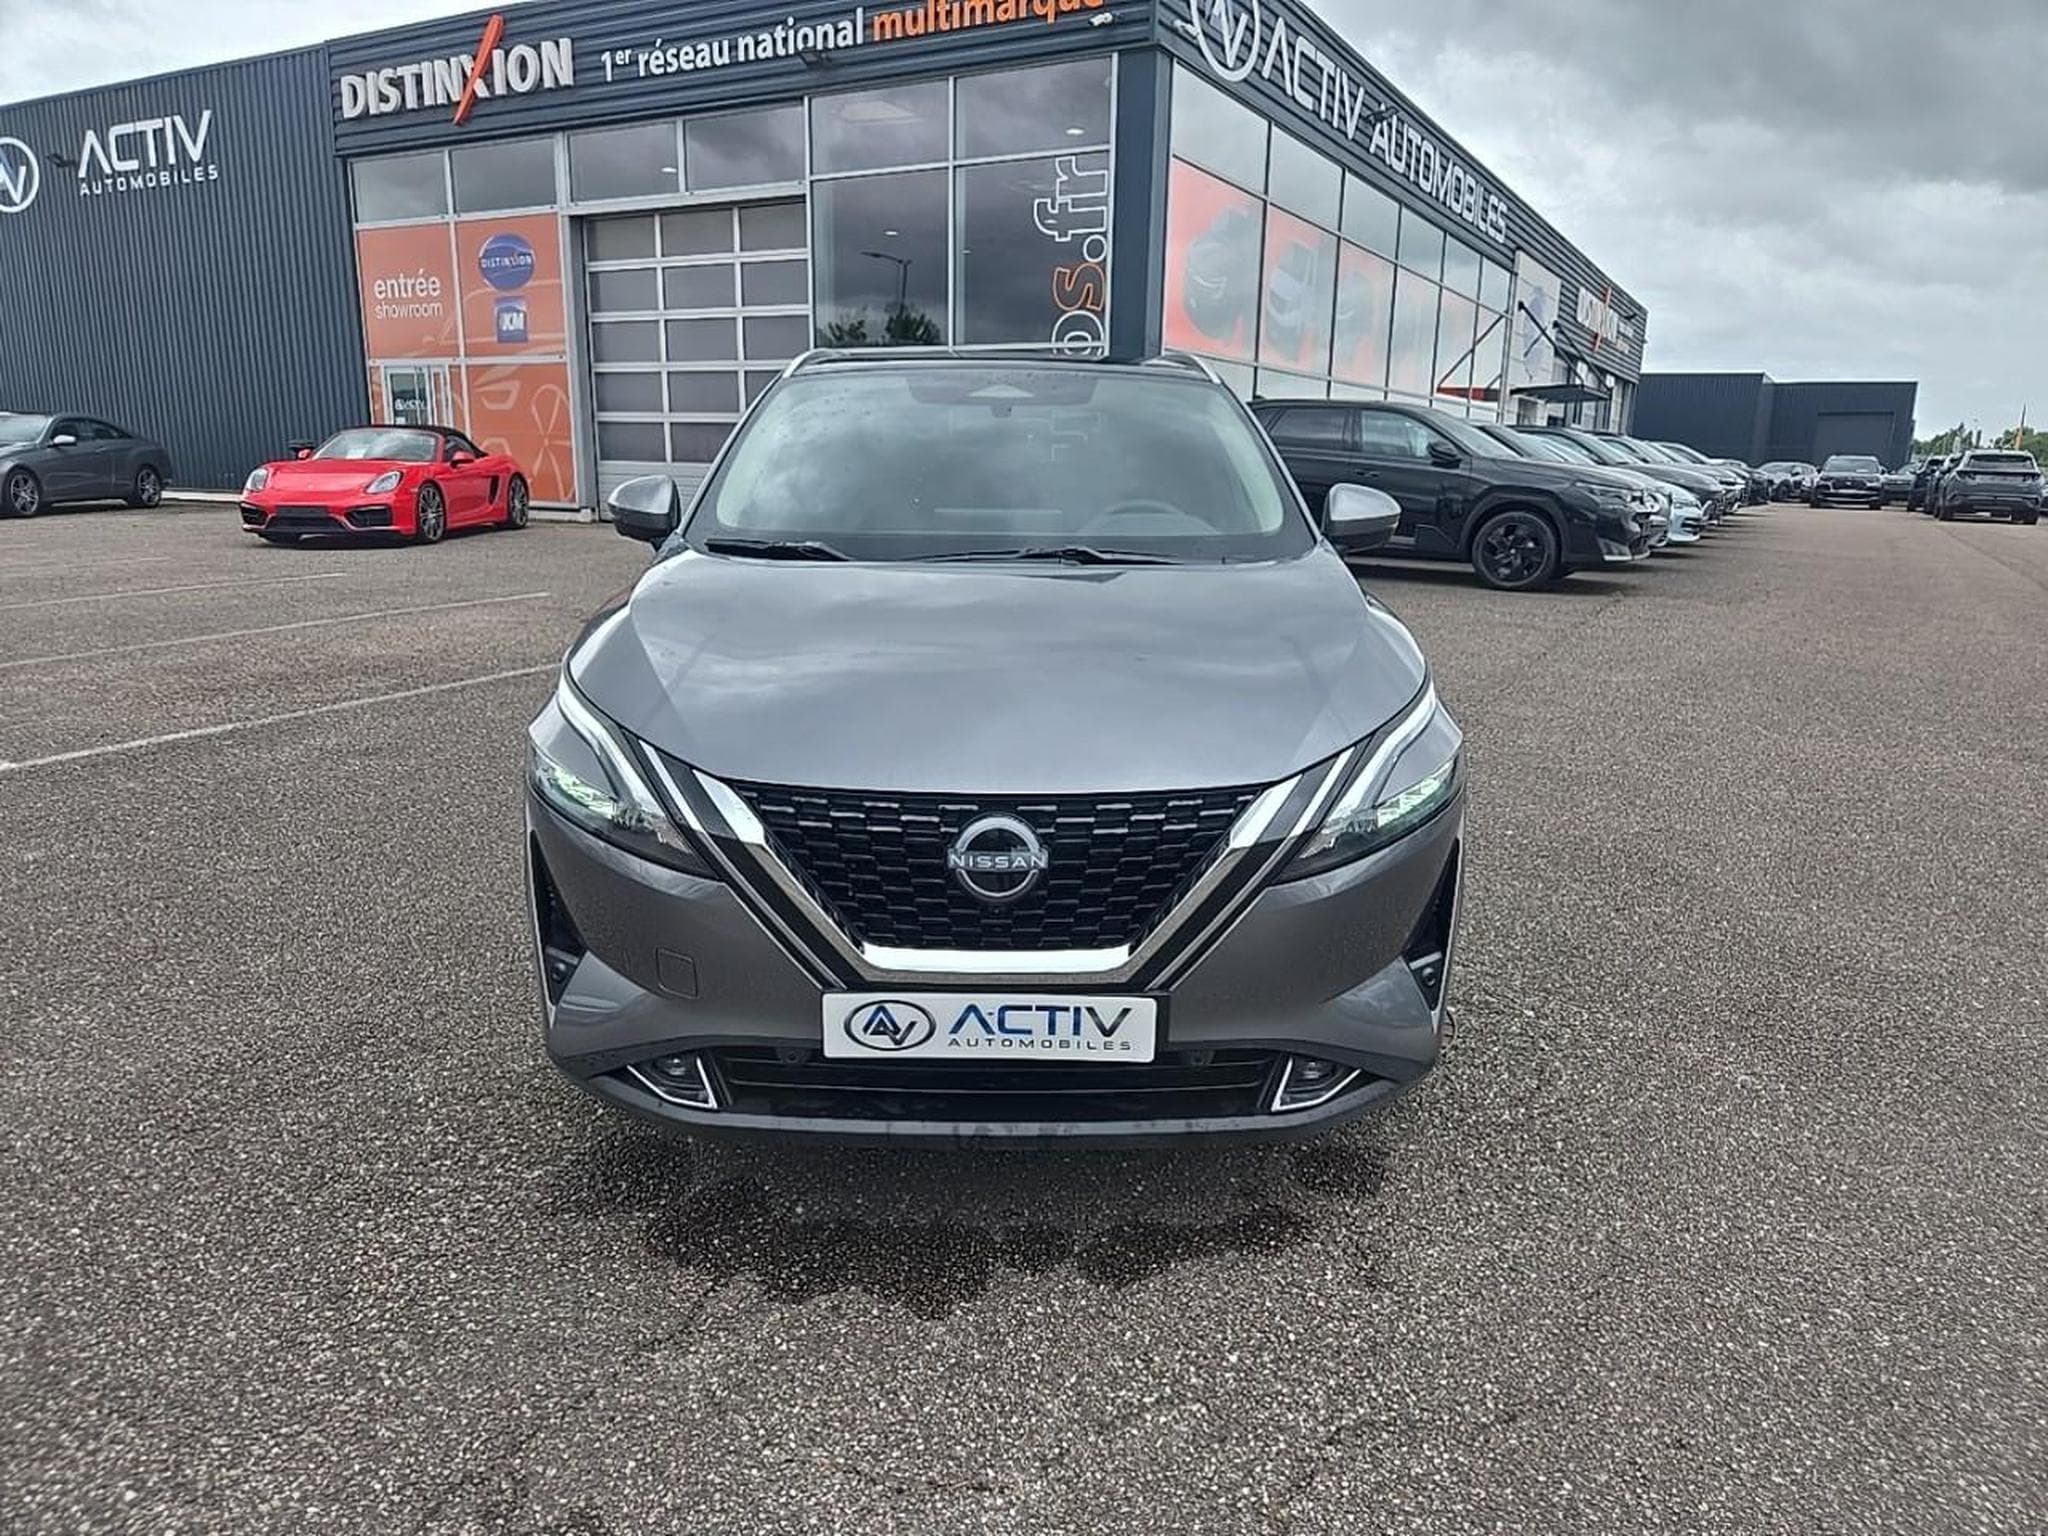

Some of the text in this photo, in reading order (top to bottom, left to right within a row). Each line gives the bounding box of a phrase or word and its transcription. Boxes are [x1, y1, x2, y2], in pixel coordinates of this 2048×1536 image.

[600, 48, 632, 82] 1er
[637, 38, 731, 78] réseau
[737, 7, 865, 63] national
[340, 14, 576, 126] DISTINXION
[77, 108, 213, 179] ACTIV
[1261, 16, 1509, 244] ACTIV AUTOMOBILES
[79, 164, 219, 197] AUTOMOBILES
[373, 268, 442, 299] entrée
[374, 301, 444, 320] showroom
[948, 853, 1048, 869] NISSAN
[948, 1003, 1133, 1038] ACTIV
[947, 1037, 1133, 1051] AUTOMOBILES
